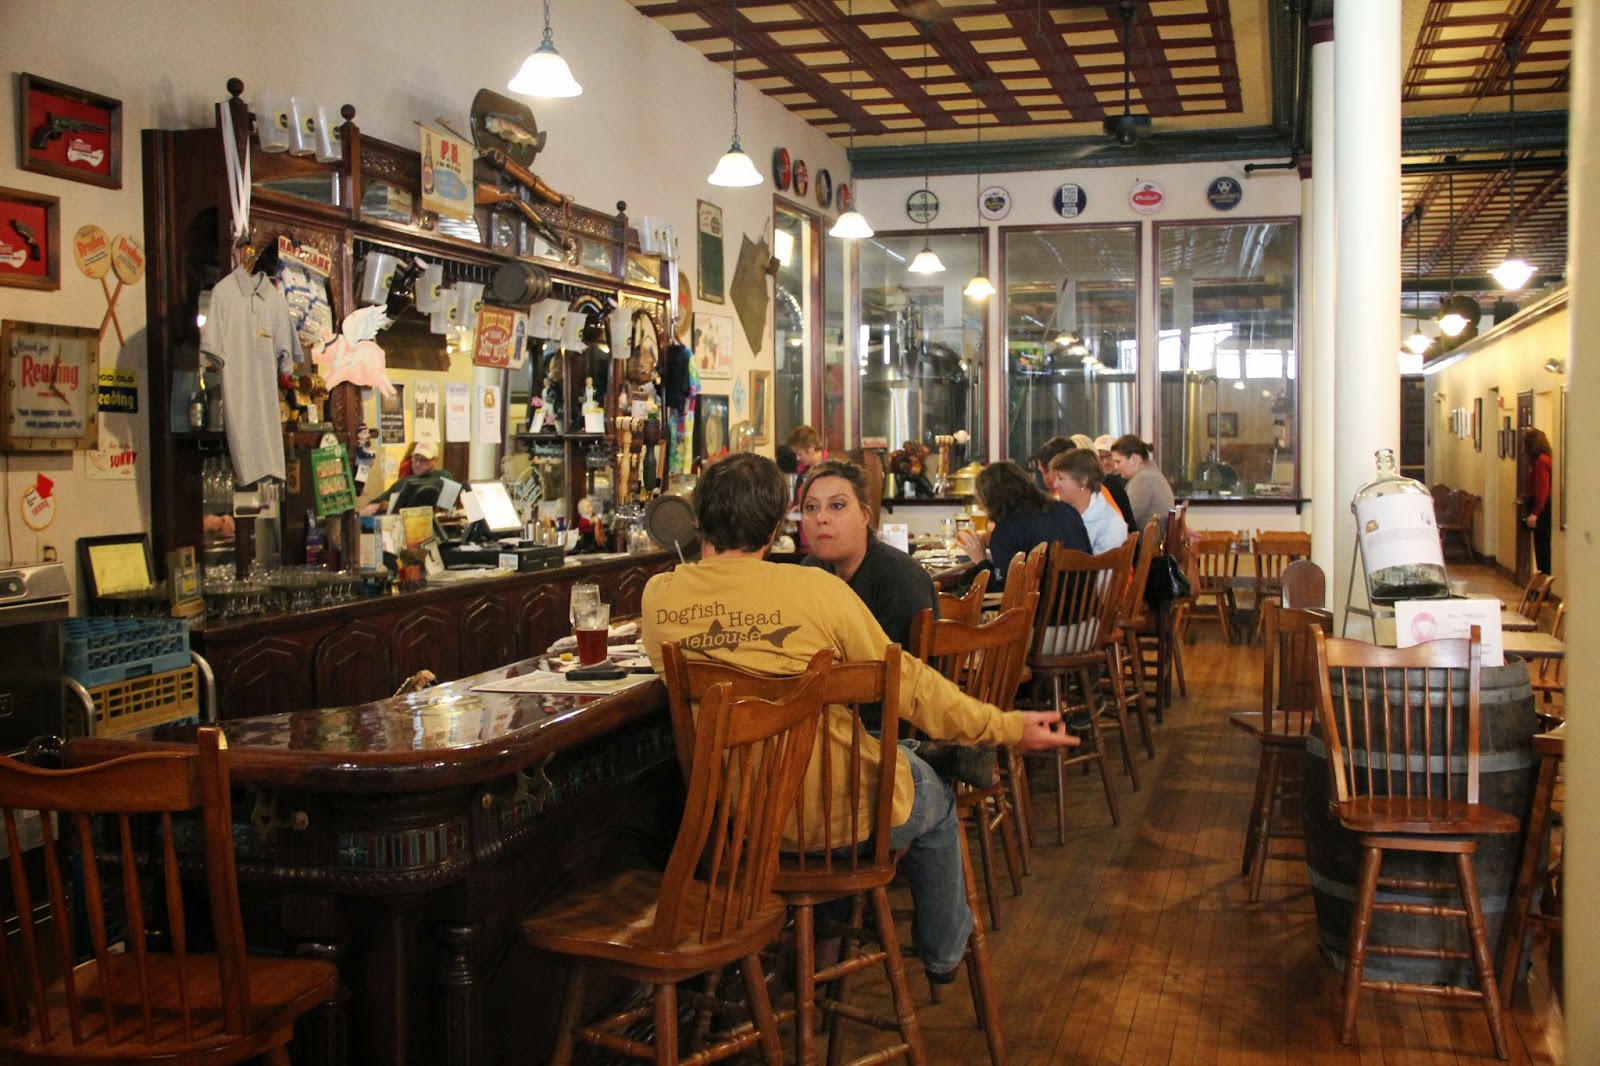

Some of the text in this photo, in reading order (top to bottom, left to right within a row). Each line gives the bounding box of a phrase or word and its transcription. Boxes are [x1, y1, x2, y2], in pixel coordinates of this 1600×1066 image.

[99, 390, 134, 409] eading
[656, 601, 784, 628] Dogfish Head
[679, 630, 762, 651] lehouse
